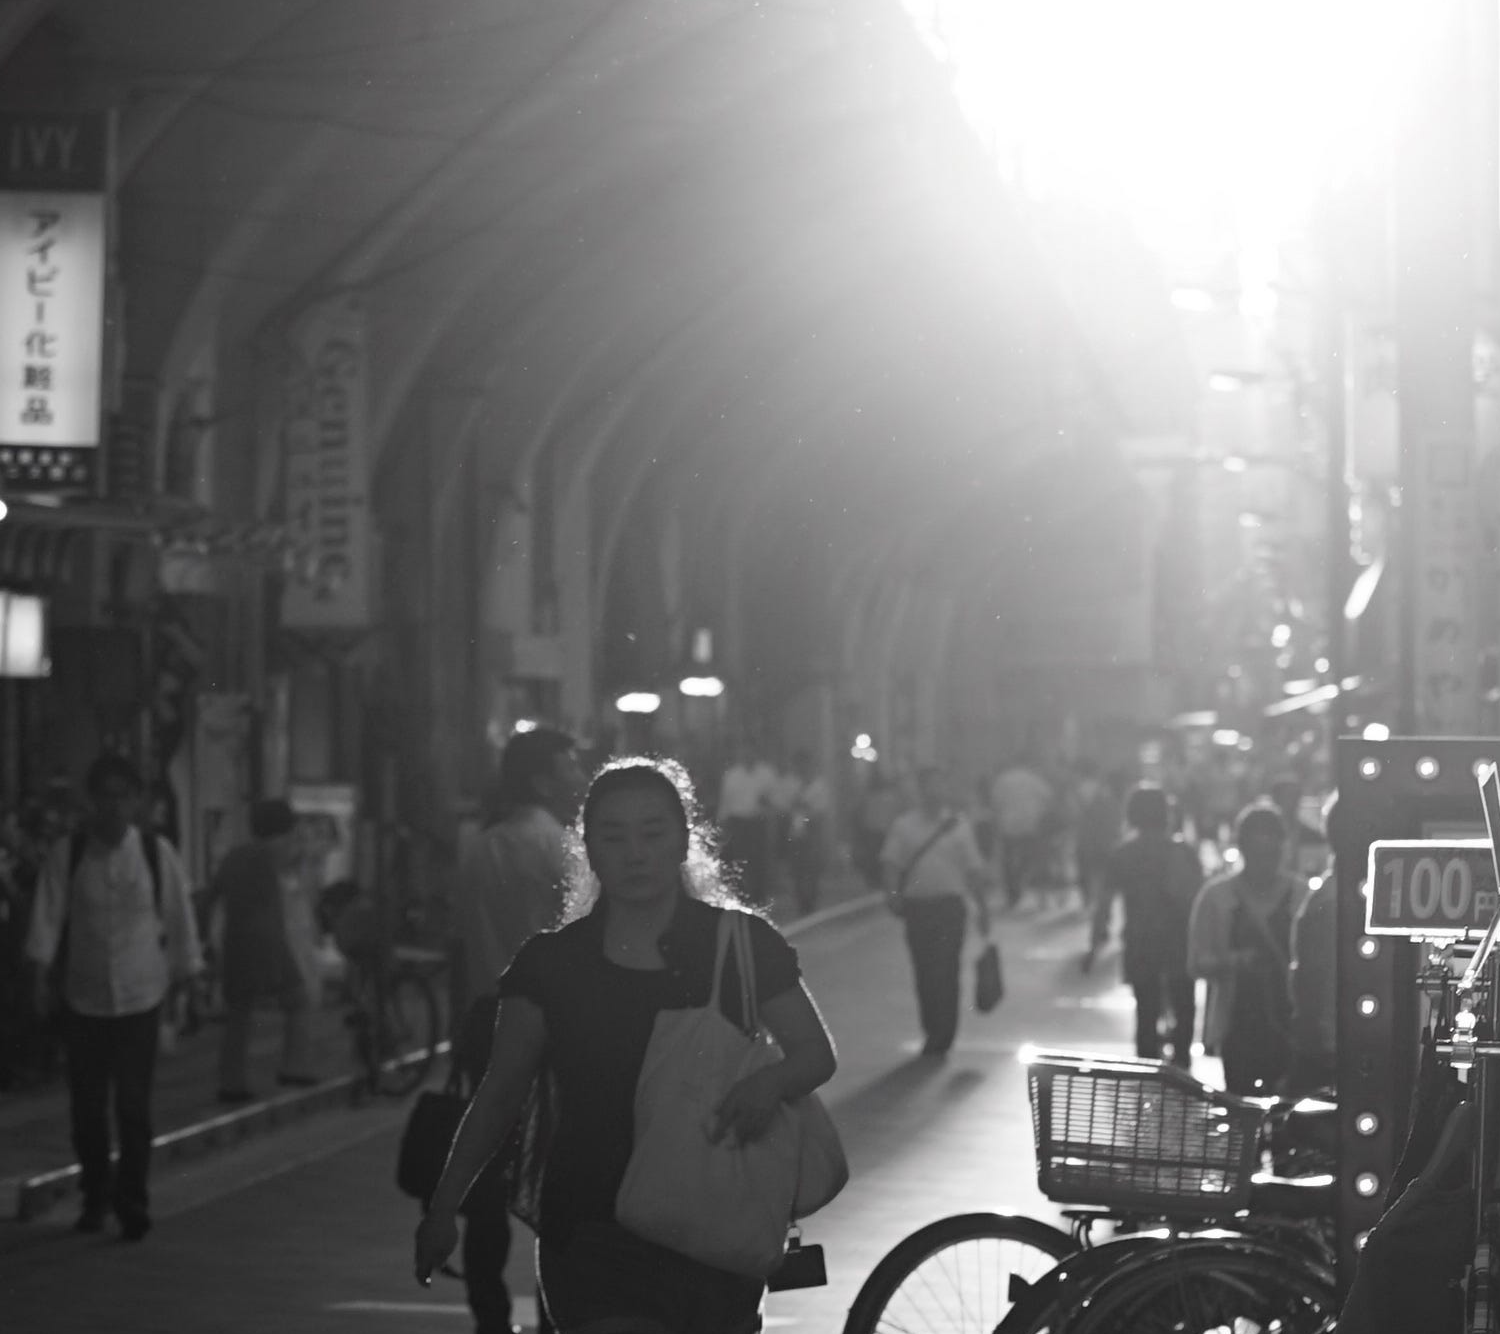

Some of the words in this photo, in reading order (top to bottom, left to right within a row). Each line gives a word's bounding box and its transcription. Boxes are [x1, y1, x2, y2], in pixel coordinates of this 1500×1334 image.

[9, 124, 80, 172] IVY
[20, 209, 62, 425] アイビー化粧品
